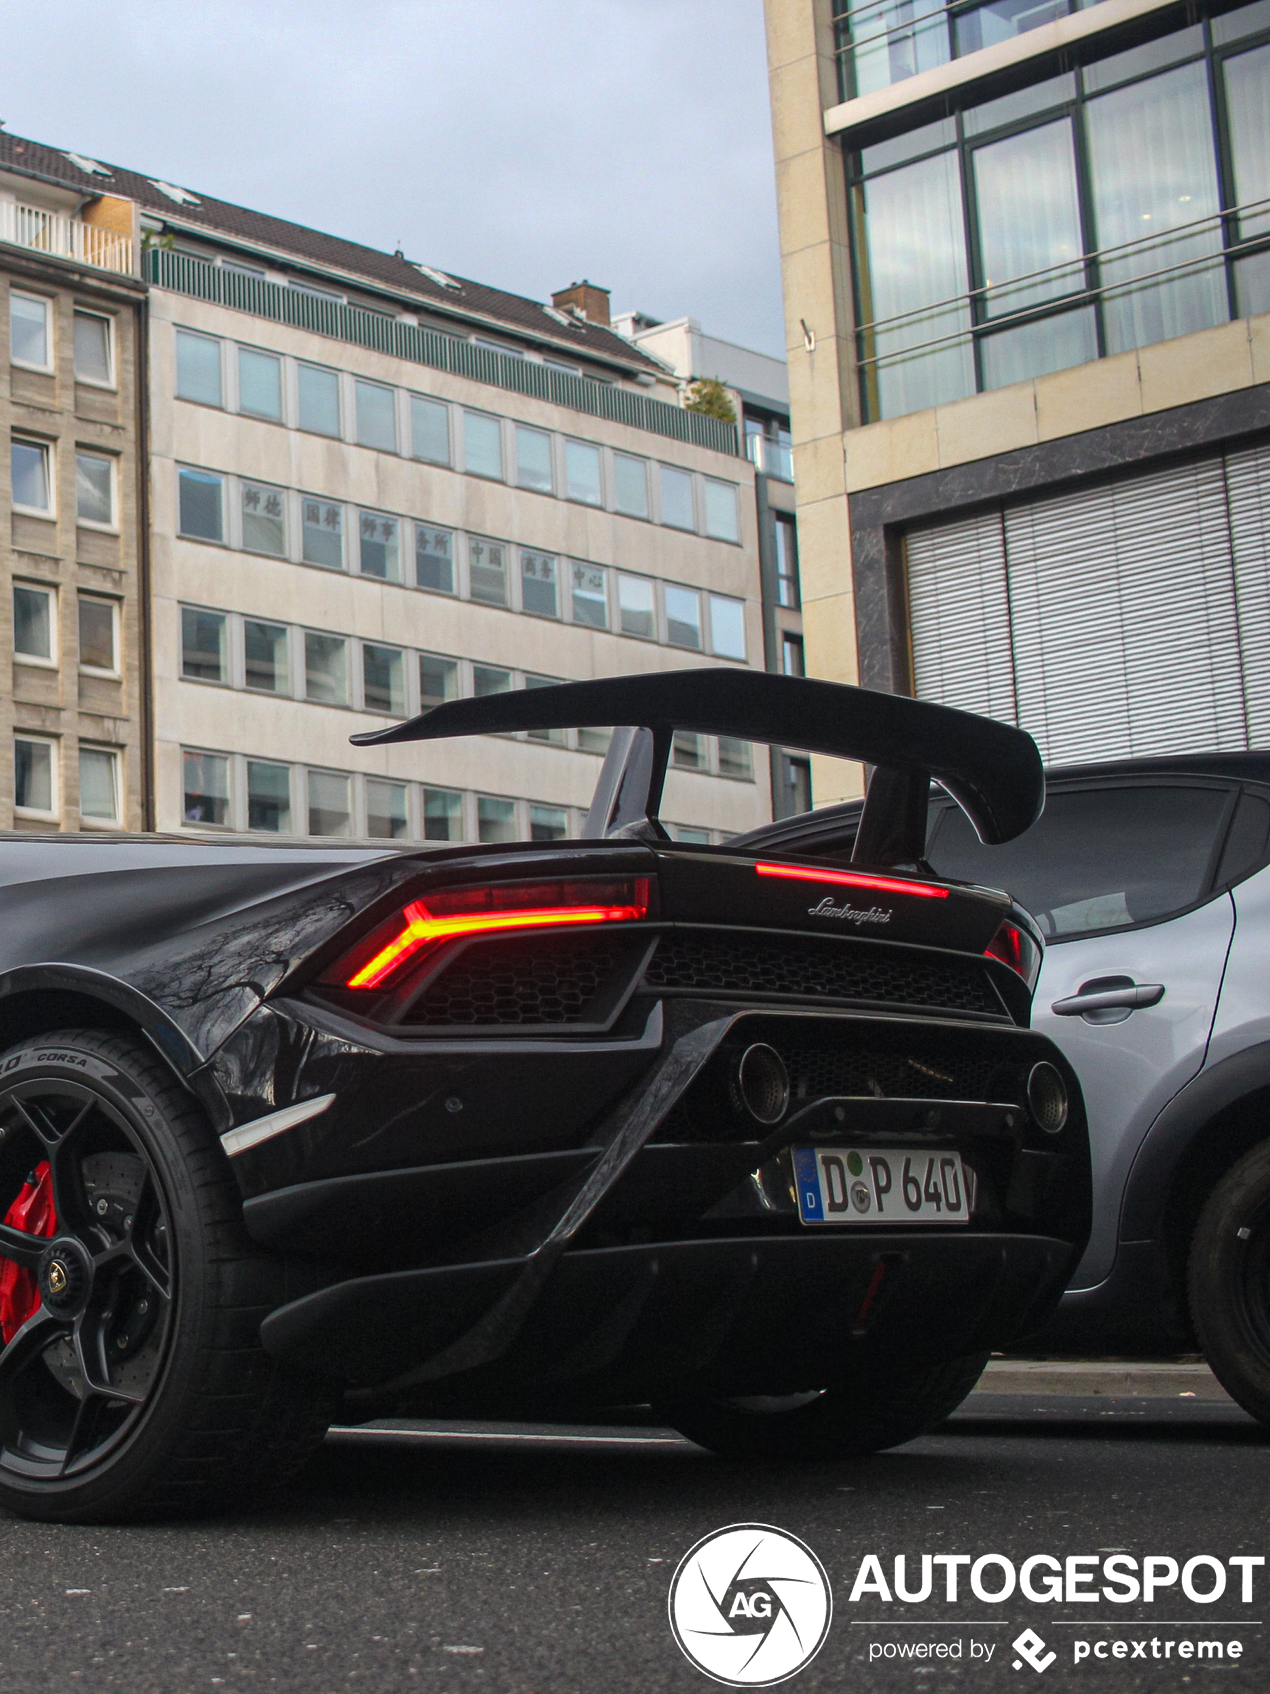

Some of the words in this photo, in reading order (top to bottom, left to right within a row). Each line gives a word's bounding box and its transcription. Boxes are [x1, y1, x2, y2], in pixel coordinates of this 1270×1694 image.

[807, 897, 893, 925] Lamborghini
[36, 1053, 88, 1068] CORSA
[820, 1154, 848, 1212] D
[868, 1156, 892, 1212] P
[901, 1156, 962, 1212] 640
